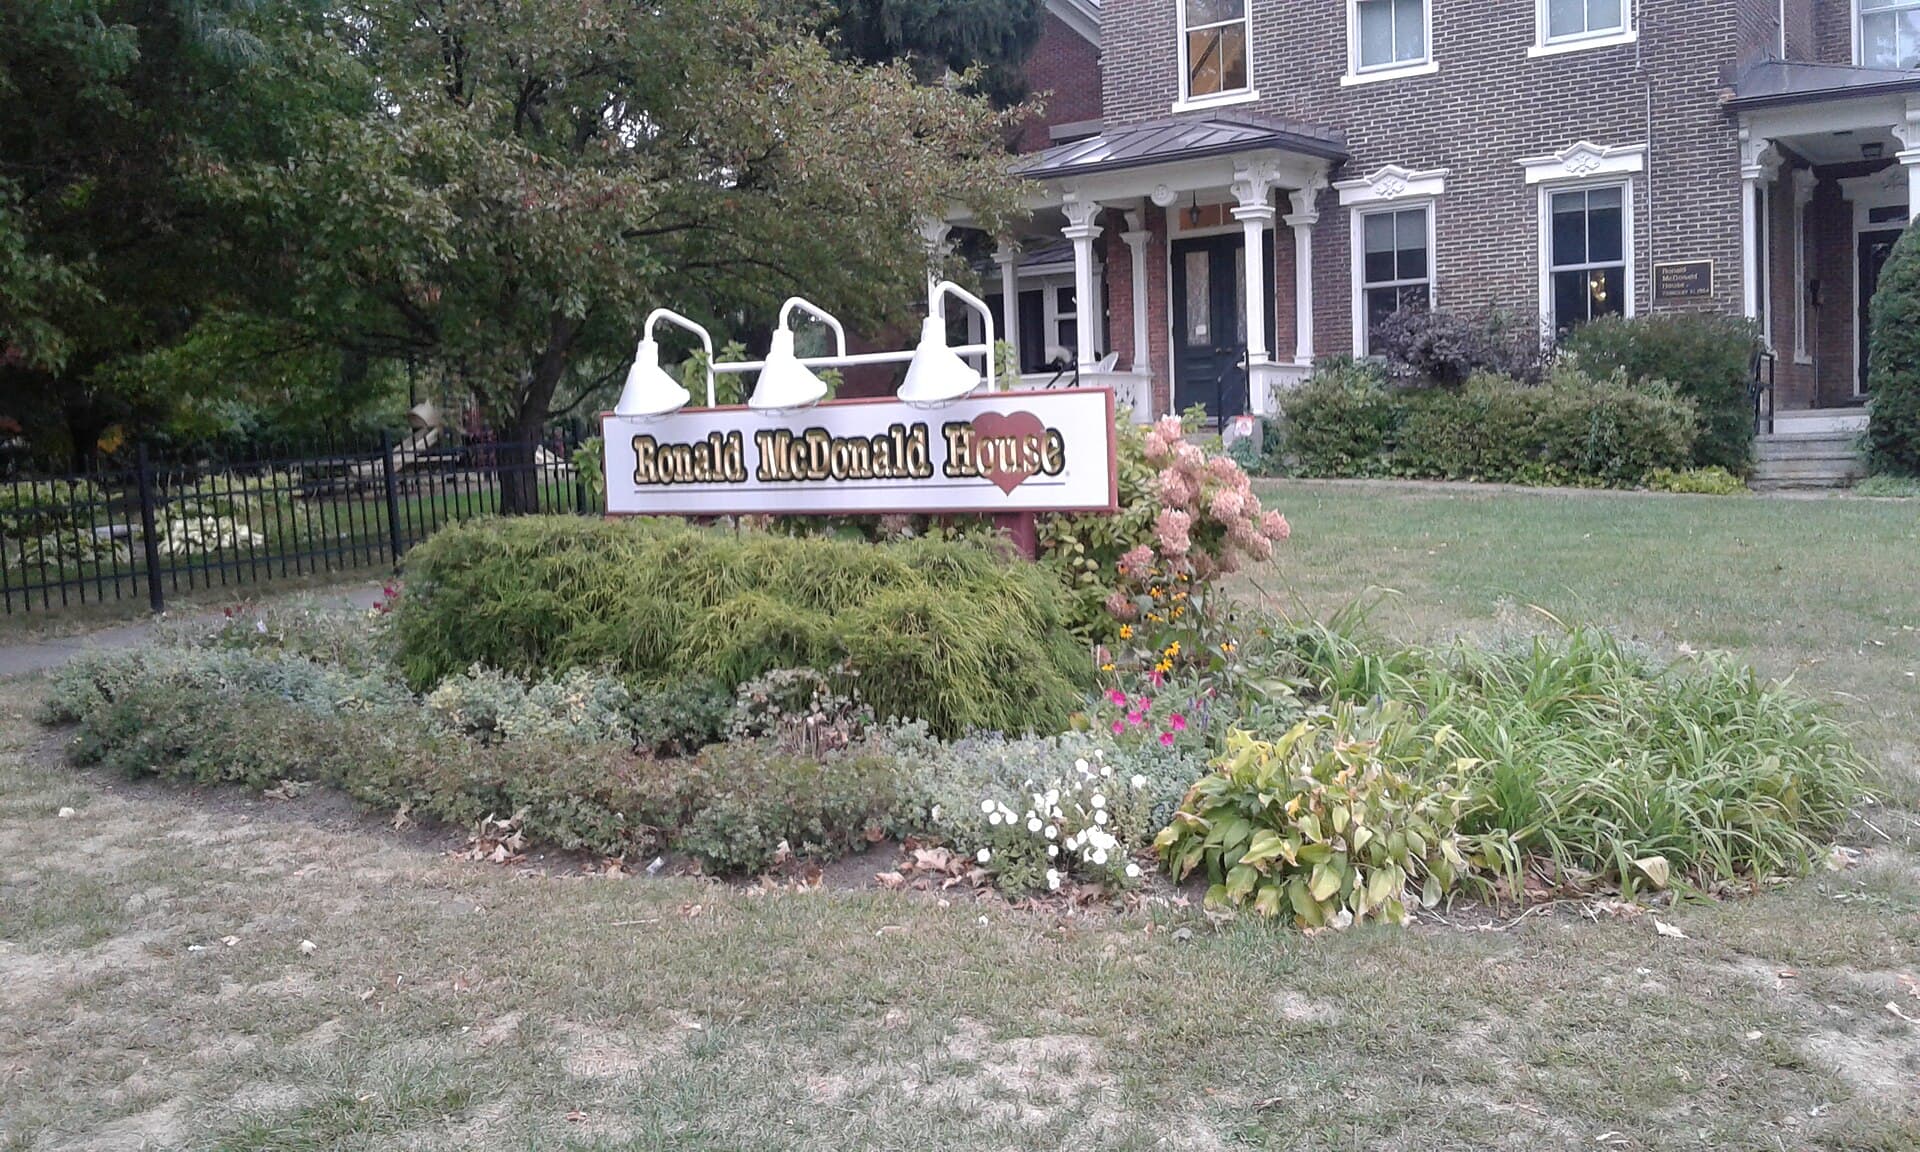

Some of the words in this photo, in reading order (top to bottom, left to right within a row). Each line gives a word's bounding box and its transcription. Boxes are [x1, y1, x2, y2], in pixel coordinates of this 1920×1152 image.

[1662, 273, 1698, 281] McDonald
[632, 432, 747, 485] Ronald
[755, 423, 933, 481] McDonald
[943, 421, 1065, 481] House
